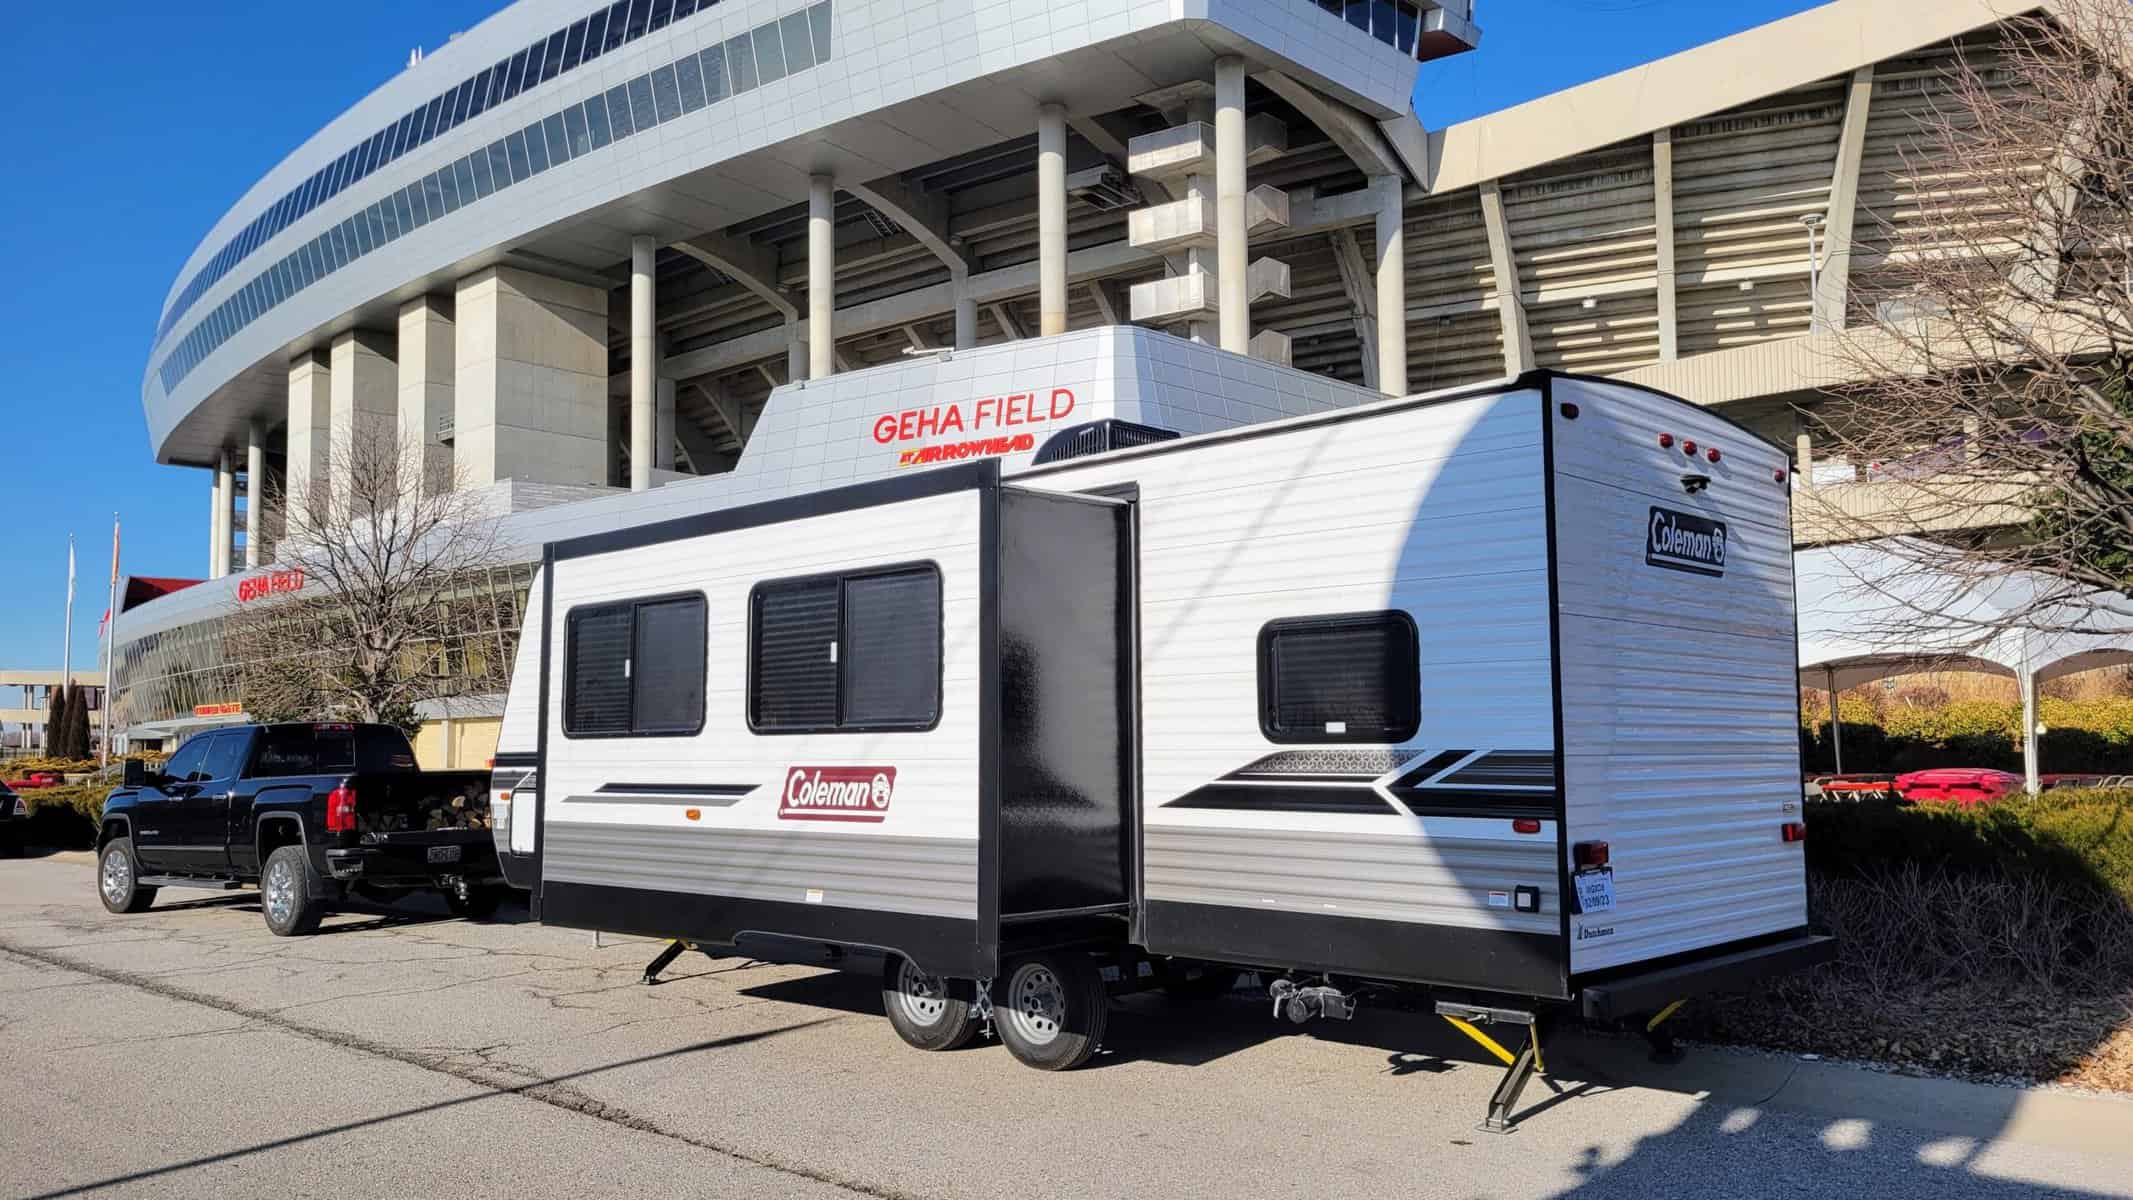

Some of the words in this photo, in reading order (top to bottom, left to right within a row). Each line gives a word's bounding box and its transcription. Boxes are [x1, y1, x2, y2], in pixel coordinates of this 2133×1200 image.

[873, 404, 964, 444] GEHA
[974, 388, 1075, 430] FIELD
[911, 433, 1034, 464] ARROWHEAD
[1651, 511, 1712, 560] Coleman
[787, 769, 870, 807] Coleman
